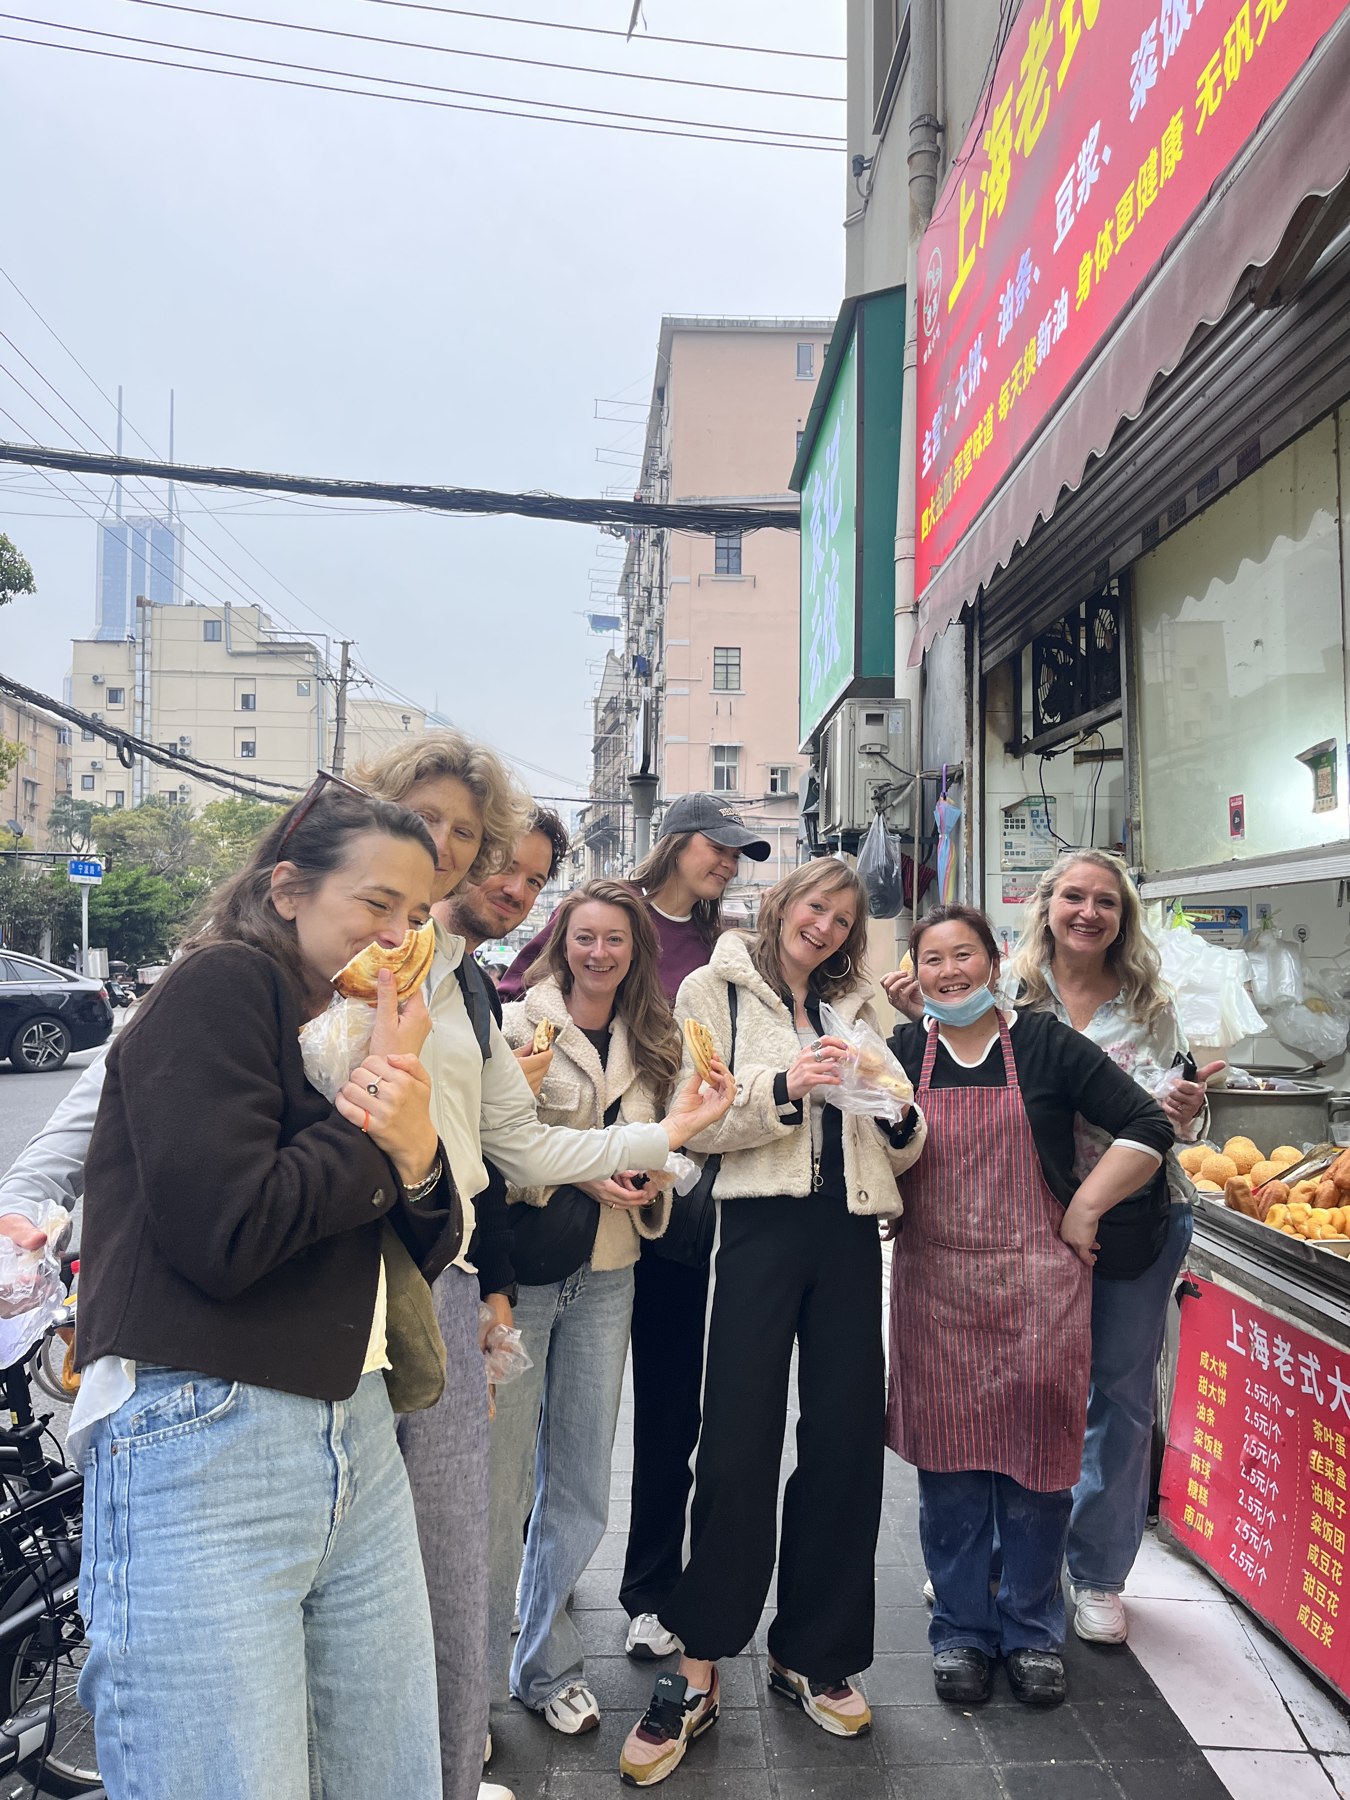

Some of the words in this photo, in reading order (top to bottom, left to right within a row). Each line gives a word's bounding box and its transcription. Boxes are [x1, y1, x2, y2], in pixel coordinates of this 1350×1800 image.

[1075, 107, 1184, 313] 身体更健康
[1199, 1351, 1228, 1381] 咸大饼
[1245, 1378, 1281, 1414] 2.5元/个
[1197, 1375, 1227, 1407] 甜大饼
[1244, 1406, 1282, 1443] 2.5元/个
[1193, 1427, 1223, 1461] 粢饭糕
[1196, 1401, 1216, 1427] 油条
[1243, 1434, 1281, 1472] 2.5元/个
[1312, 1419, 1347, 1459] 茶叶蛋
[1190, 1453, 1211, 1481] 麻球
[1238, 1489, 1276, 1530] 2.5元/个
[1310, 1450, 1347, 1491] 韭菜盒
[1187, 1478, 1209, 1508] 糖糕
[1234, 1516, 1273, 1559] 25元/个
[1311, 1480, 1347, 1520] 油墩子
[1183, 1504, 1215, 1541] 南瓜饼
[1229, 1543, 1267, 1587] 2.5元/个
[1310, 1511, 1346, 1555] 粢饭团
[1307, 1543, 1344, 1586] 咸豆花
[1303, 1571, 1340, 1618] 甜豆花
[1297, 1603, 1335, 1649] 咸豆浆
